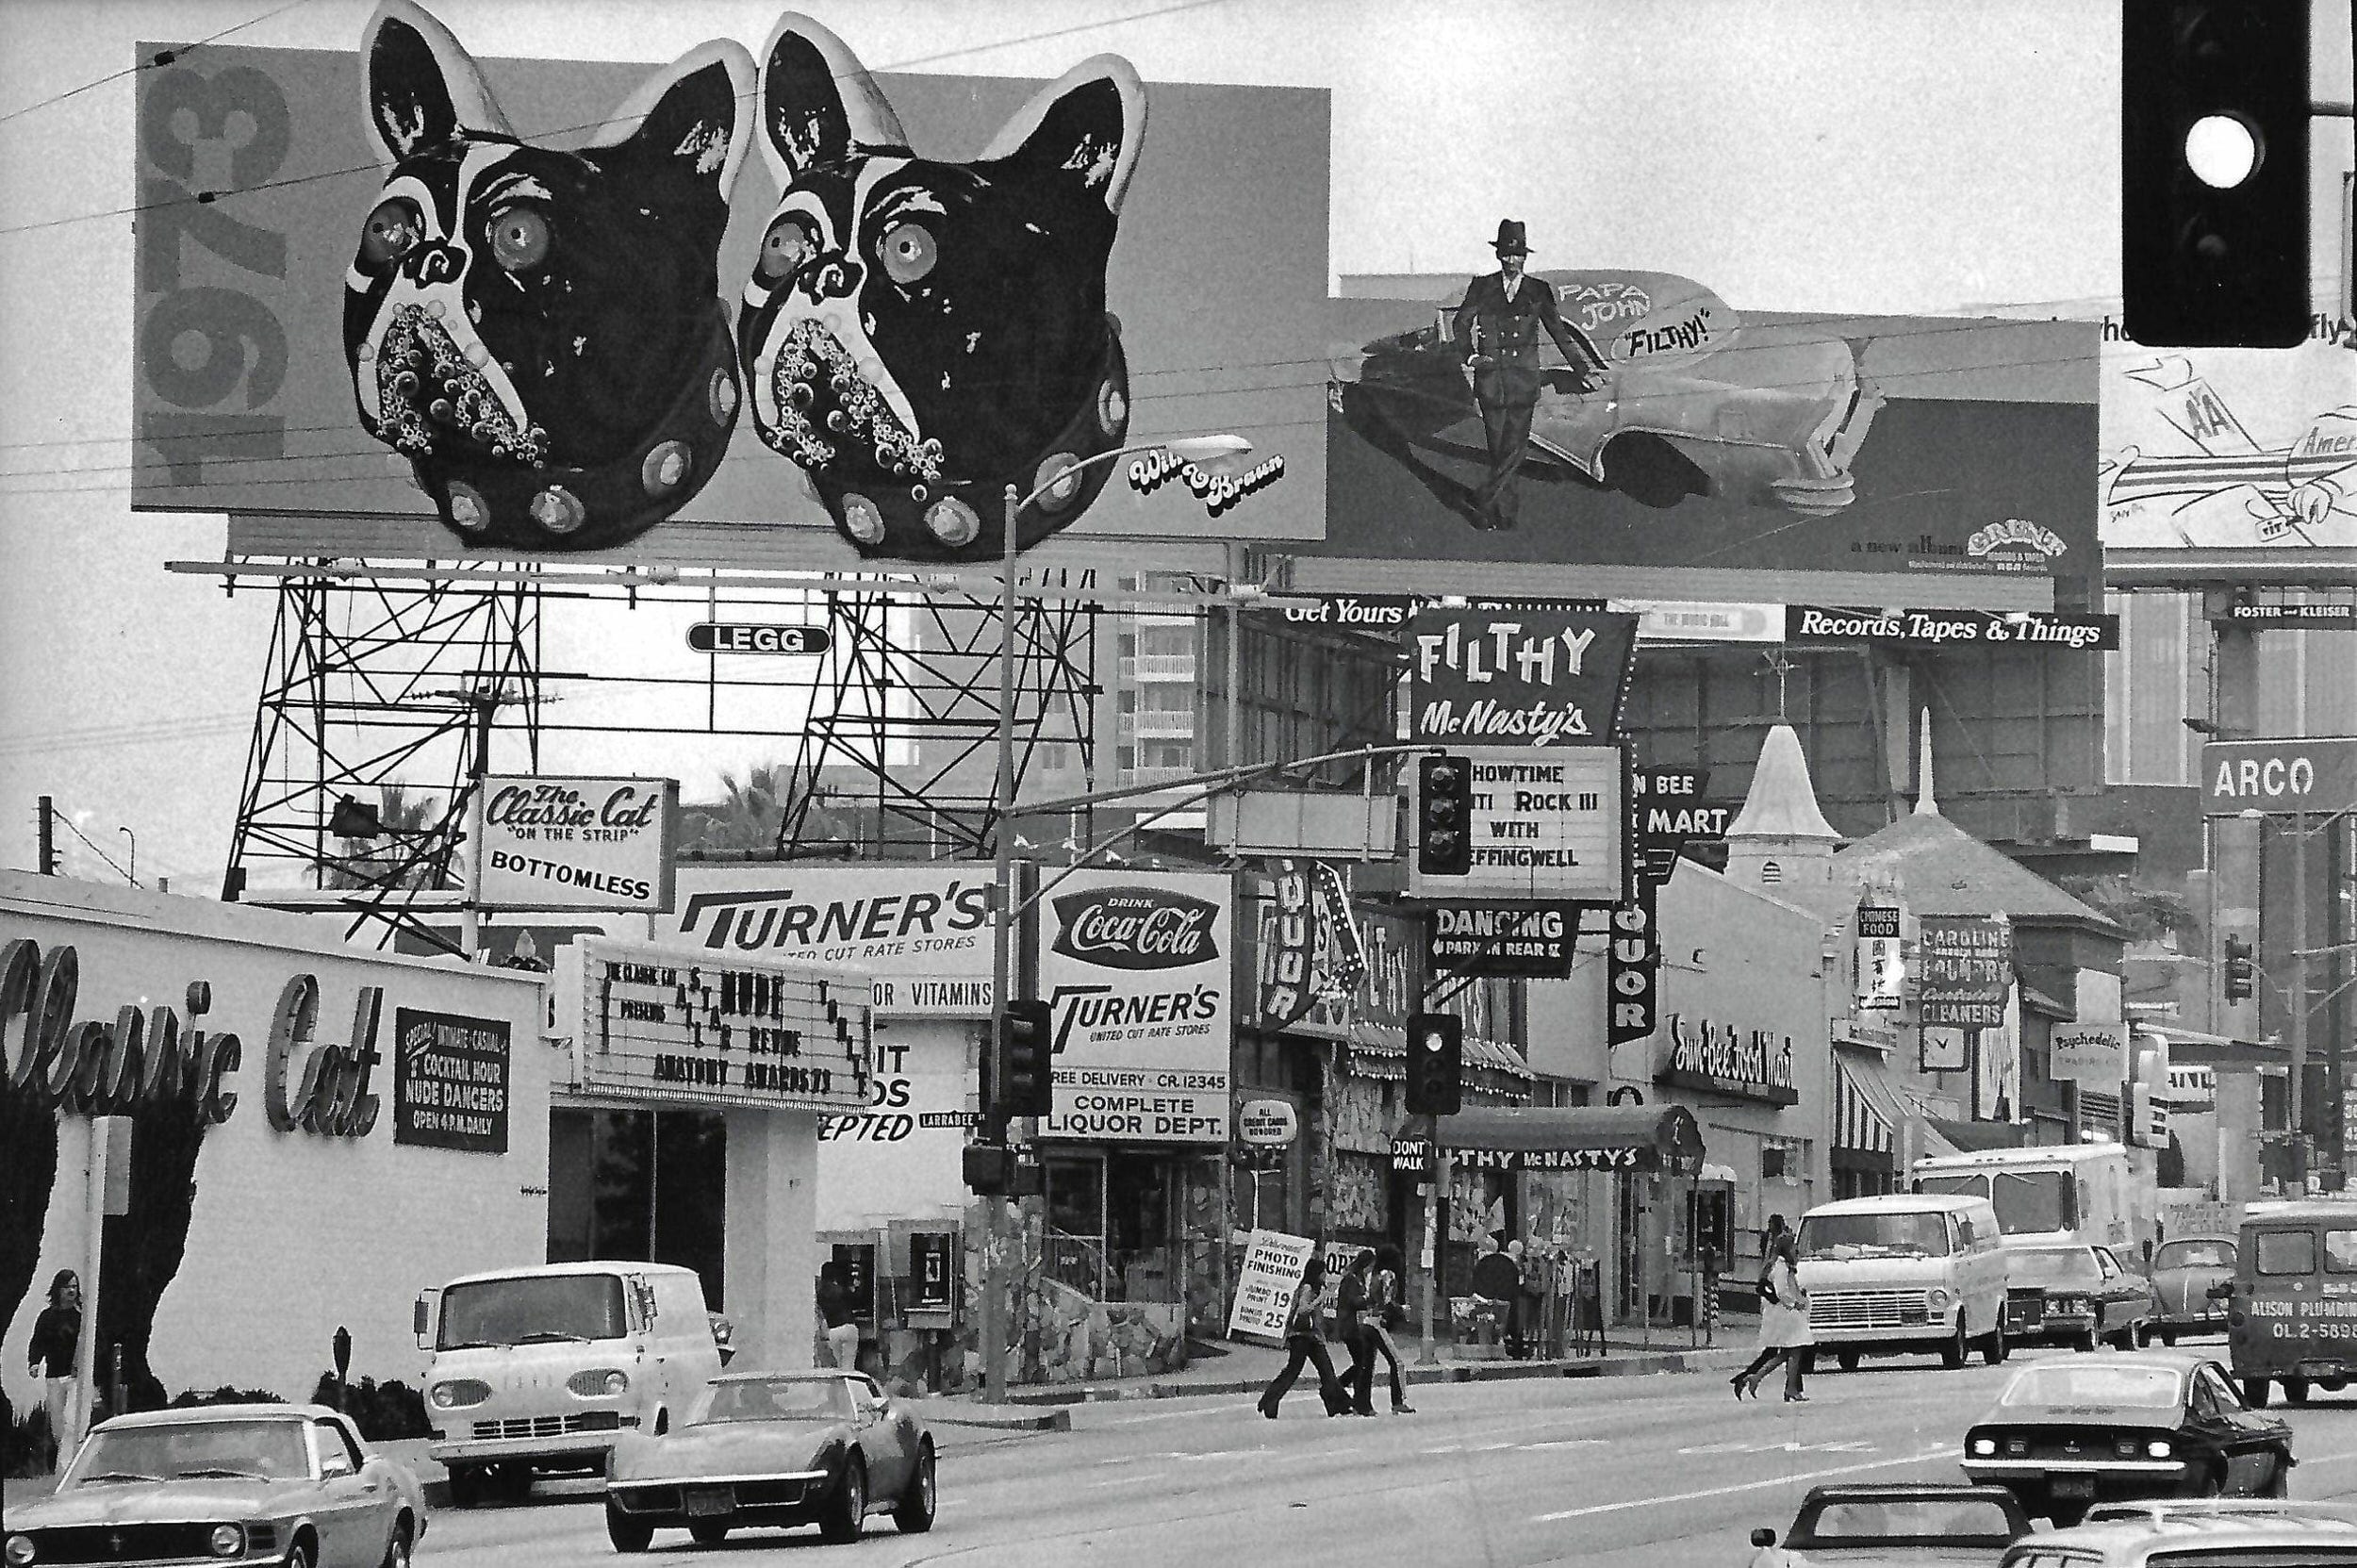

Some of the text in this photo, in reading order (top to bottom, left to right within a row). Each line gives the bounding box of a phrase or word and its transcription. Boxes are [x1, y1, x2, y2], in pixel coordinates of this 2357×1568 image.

[1558, 283, 1650, 302] PAPA
[1580, 299, 1650, 331] JOHN
[1336, 598, 1404, 624] Yours
[2233, 606, 2282, 618] FOSTER
[2299, 606, 2350, 618] KLEISER
[1799, 608, 2102, 648] Records, Tapes & Things
[714, 626, 805, 652] LEGG
[1416, 621, 1596, 685] FILTHY
[1419, 698, 1593, 747] McNasty's
[1472, 765, 1565, 784] HOWTIME
[2214, 756, 2315, 798] ARCO
[534, 784, 579, 803] The
[1656, 775, 1695, 795] BEE
[486, 785, 659, 829] Classic Cat
[1579, 793, 1598, 811] III
[1489, 821, 1540, 838] WITH
[1647, 808, 1728, 834] MART
[543, 827, 574, 841] THE
[1470, 850, 1579, 867] EFFINGWELL
[489, 850, 651, 901] BOTTOMLESS
[1107, 898, 1155, 909] DRINK
[679, 881, 986, 951] TURNER'S
[1436, 908, 1564, 939] DANCING
[1859, 910, 1899, 923] CHINESE
[1070, 905, 1207, 955] Coca-Cola
[1863, 923, 1895, 935] FOOD
[1922, 927, 2011, 948] CAROLINE
[825, 948, 856, 962] CUT
[864, 944, 905, 958] RATE
[912, 936, 977, 953] STORES
[1486, 941, 1501, 956] N
[1506, 942, 1545, 957] REAR
[873, 982, 991, 1006] OR VITAMINS
[1050, 983, 1220, 1055] TURNER'S
[1922, 1003, 2002, 1024] CLEANERS
[1089, 1024, 1211, 1043] UNITED CUT RATE STORES
[2055, 1031, 2121, 1051] Psychedelic
[423, 1053, 471, 1081] COCKTAIL
[473, 1060, 502, 1084] HOUR
[875, 1045, 911, 1074] IT
[1052, 1071, 1077, 1084] REE
[1080, 1072, 1146, 1086] DELIVERY
[1182, 1075, 1227, 1089] 12345
[404, 1079, 504, 1113] NUDE DANCERS
[1074, 1095, 1195, 1114] COMPLETE
[413, 1109, 440, 1131] OPEN
[922, 1113, 974, 1127] LARRABEE
[1259, 1108, 1272, 1117] ALL
[818, 1113, 915, 1142] EPTED
[1047, 1114, 1223, 1136] LIQUOR DEPT.
[1393, 1140, 1426, 1156] DONT
[1393, 1156, 1426, 1171] WALK
[1524, 1147, 1639, 1170] McNASTY'S
[1254, 1248, 1299, 1267] PHOTO
[1247, 1260, 1303, 1279] FINISHING
[1244, 1284, 1272, 1297] JUMBO
[1246, 1293, 1269, 1304] PRINT
[1274, 1291, 1291, 1308] 19
[2250, 1301, 2294, 1317] ALISON
[1263, 1312, 1285, 1329] 25
